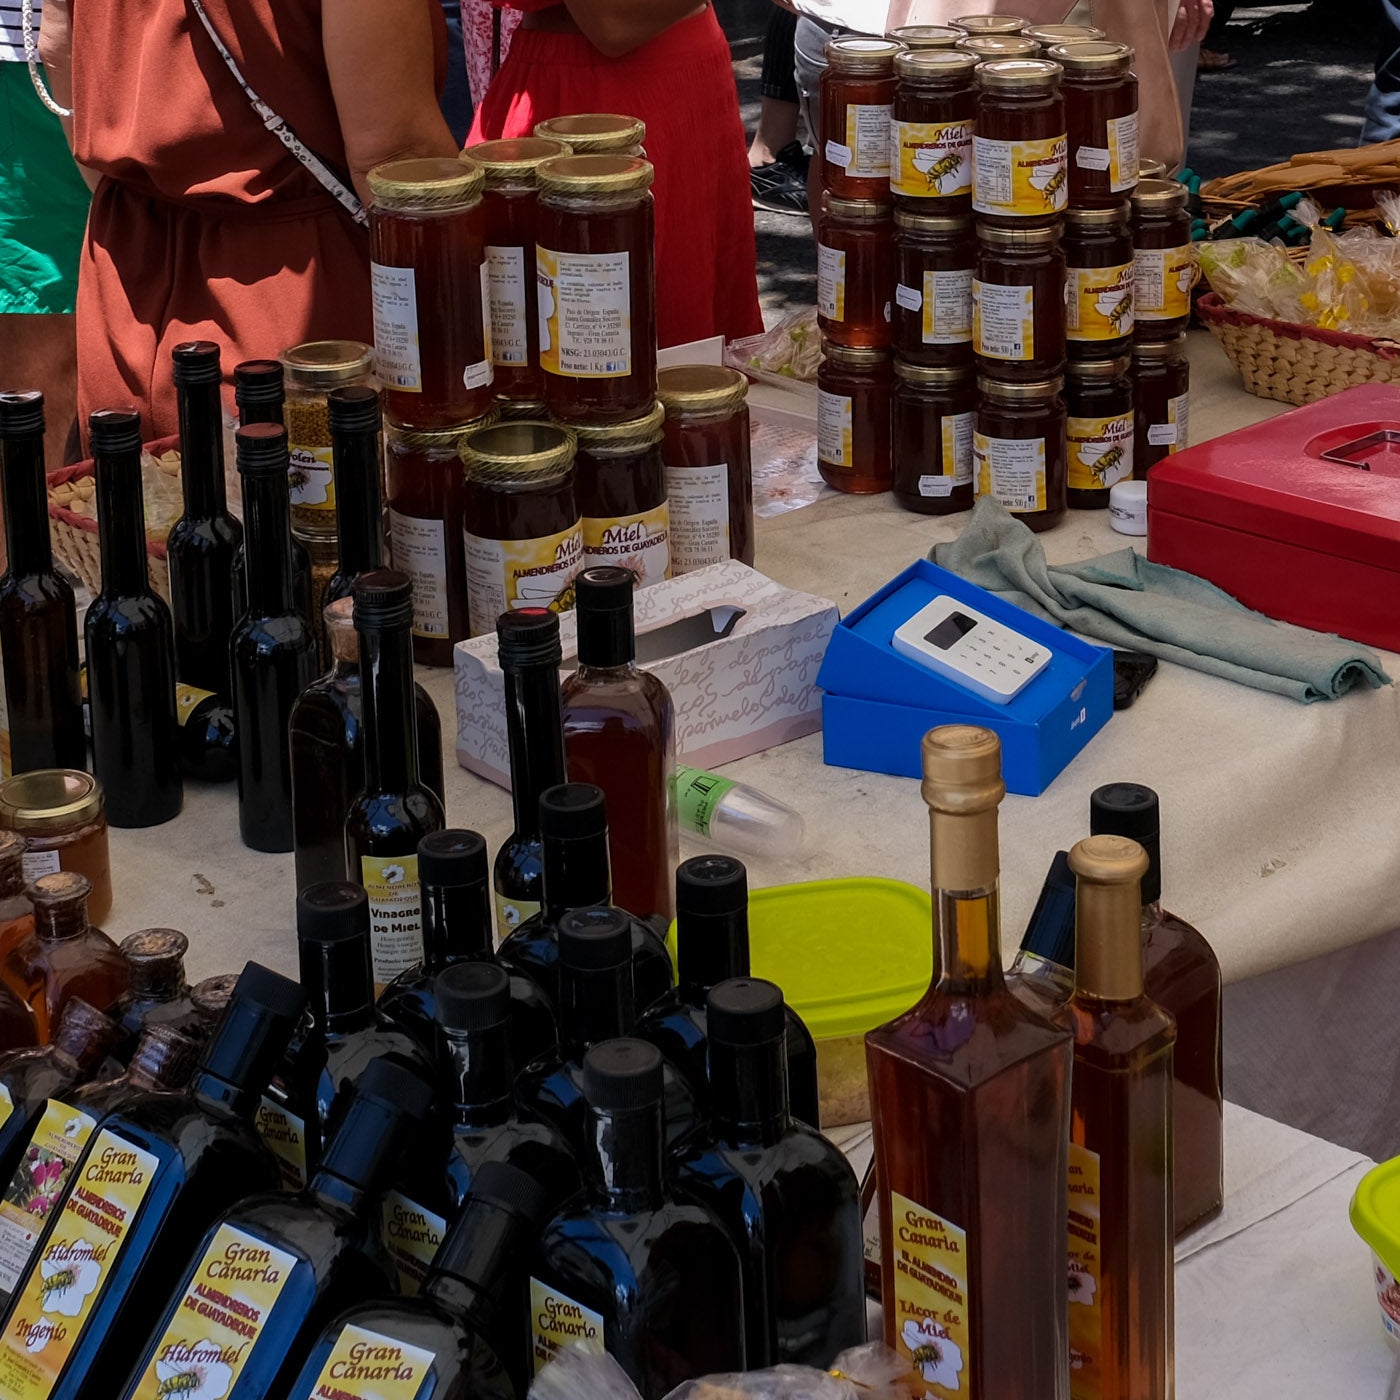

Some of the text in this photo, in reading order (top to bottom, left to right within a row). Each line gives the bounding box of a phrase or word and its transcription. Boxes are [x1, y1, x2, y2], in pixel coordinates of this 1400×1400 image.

[934, 124, 965, 142] Miel
[1101, 418, 1126, 436] Miel
[602, 520, 644, 544] Miel
[620, 543, 630, 554] DE
[513, 561, 568, 579] ALMENDREROS
[260, 1106, 287, 1126] Gran
[256, 1122, 299, 1145] Canaria
[101, 1147, 137, 1167] Gran
[86, 1166, 144, 1185] Canaria
[75, 1186, 126, 1222] ALMENDREROS
[393, 1205, 426, 1225] Gran
[66, 1199, 123, 1239] DE GUAYADEQUE
[905, 1210, 945, 1232] Gran
[388, 1220, 440, 1245] Canaria
[899, 1227, 960, 1253] Canaria
[44, 1239, 116, 1262] Hidromiel
[225, 1243, 270, 1263] Gran
[206, 1260, 280, 1283] Canaria
[902, 1249, 958, 1290] EL ALMENDRO
[897, 1260, 963, 1306] DE GUAYADEQUE
[194, 1283, 260, 1323] ALMENDREROS
[544, 1296, 583, 1319] Gran
[899, 1300, 961, 1324] Licor de
[184, 1295, 257, 1339] DE GUAYADEQUE
[539, 1313, 598, 1338] Canaria
[16, 1318, 67, 1347] Ingenio
[916, 1320, 952, 1341] Miel
[161, 1339, 250, 1364] Hidromiel
[349, 1342, 401, 1363] Gran
[329, 1360, 414, 1381] Canaria
